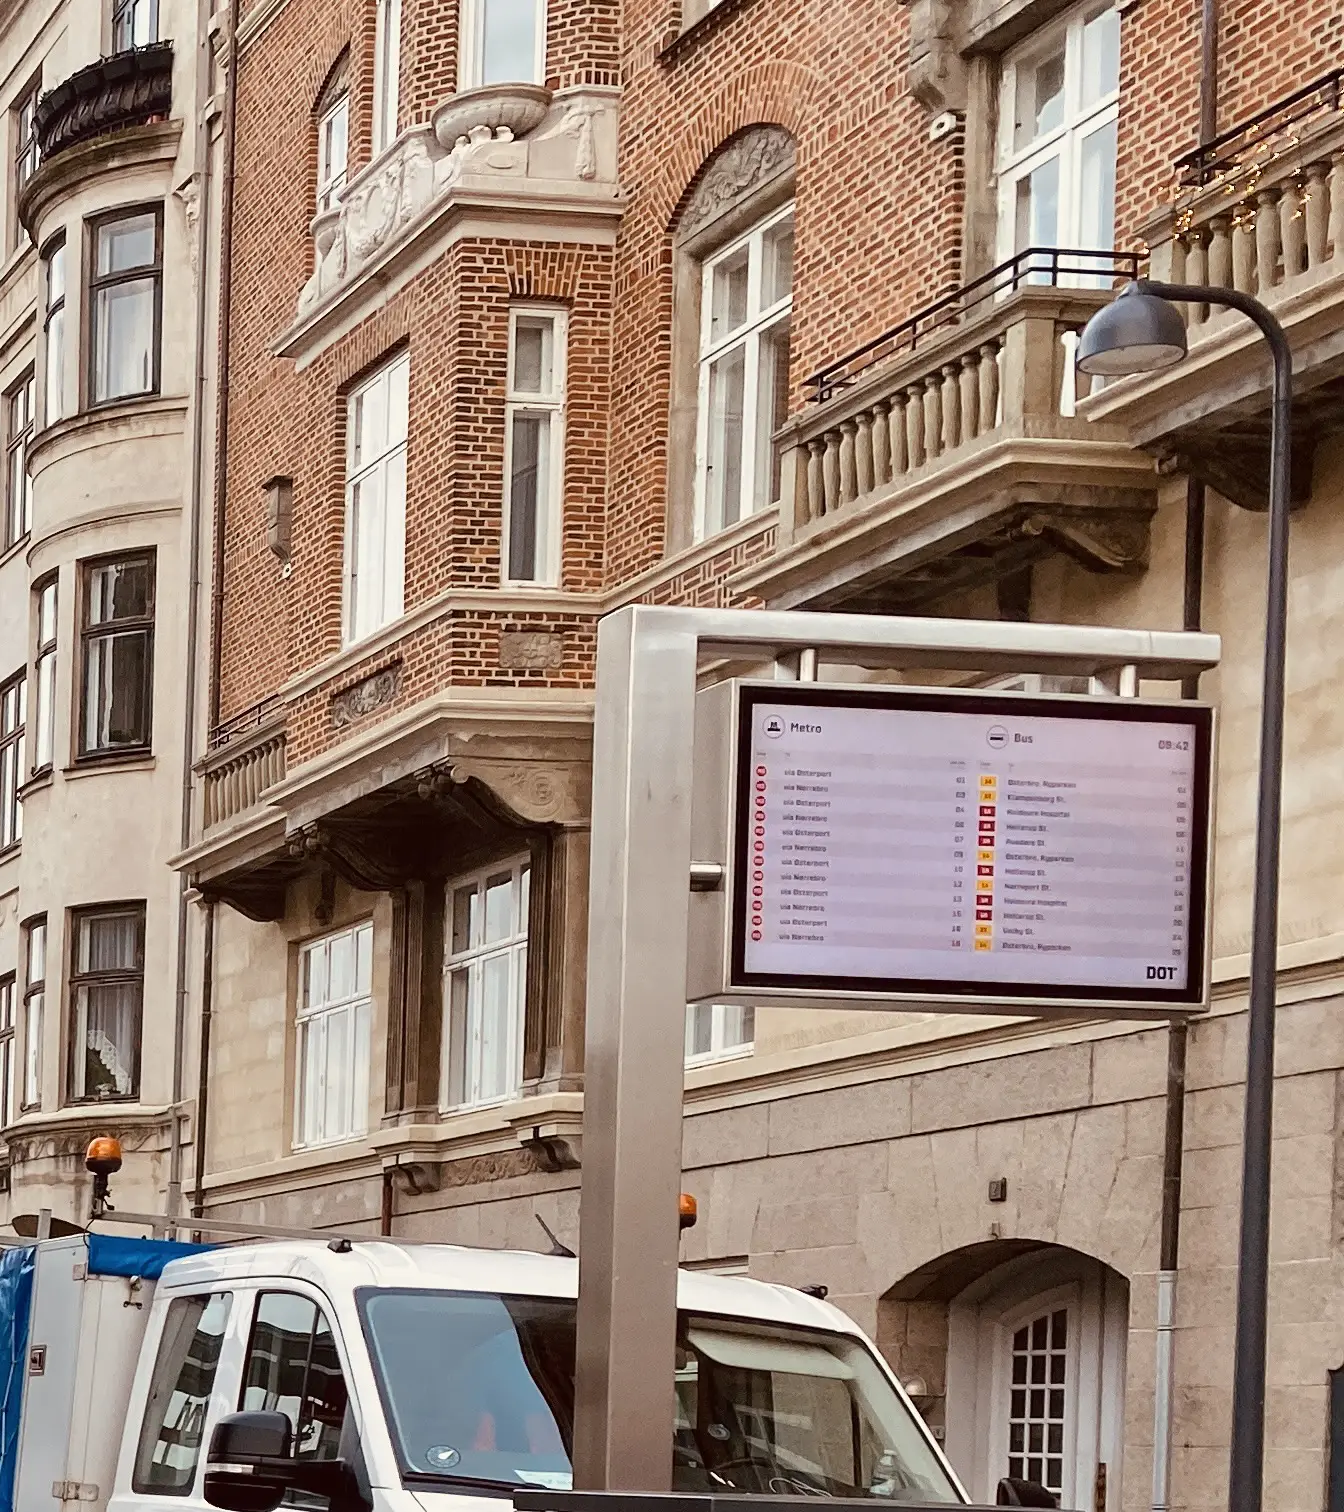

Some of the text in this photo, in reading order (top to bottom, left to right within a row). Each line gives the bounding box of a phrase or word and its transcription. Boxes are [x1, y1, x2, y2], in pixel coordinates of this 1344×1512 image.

[790, 722, 822, 734] Metro
[1014, 733, 1033, 744] Bus
[1146, 966, 1175, 980] DOT
